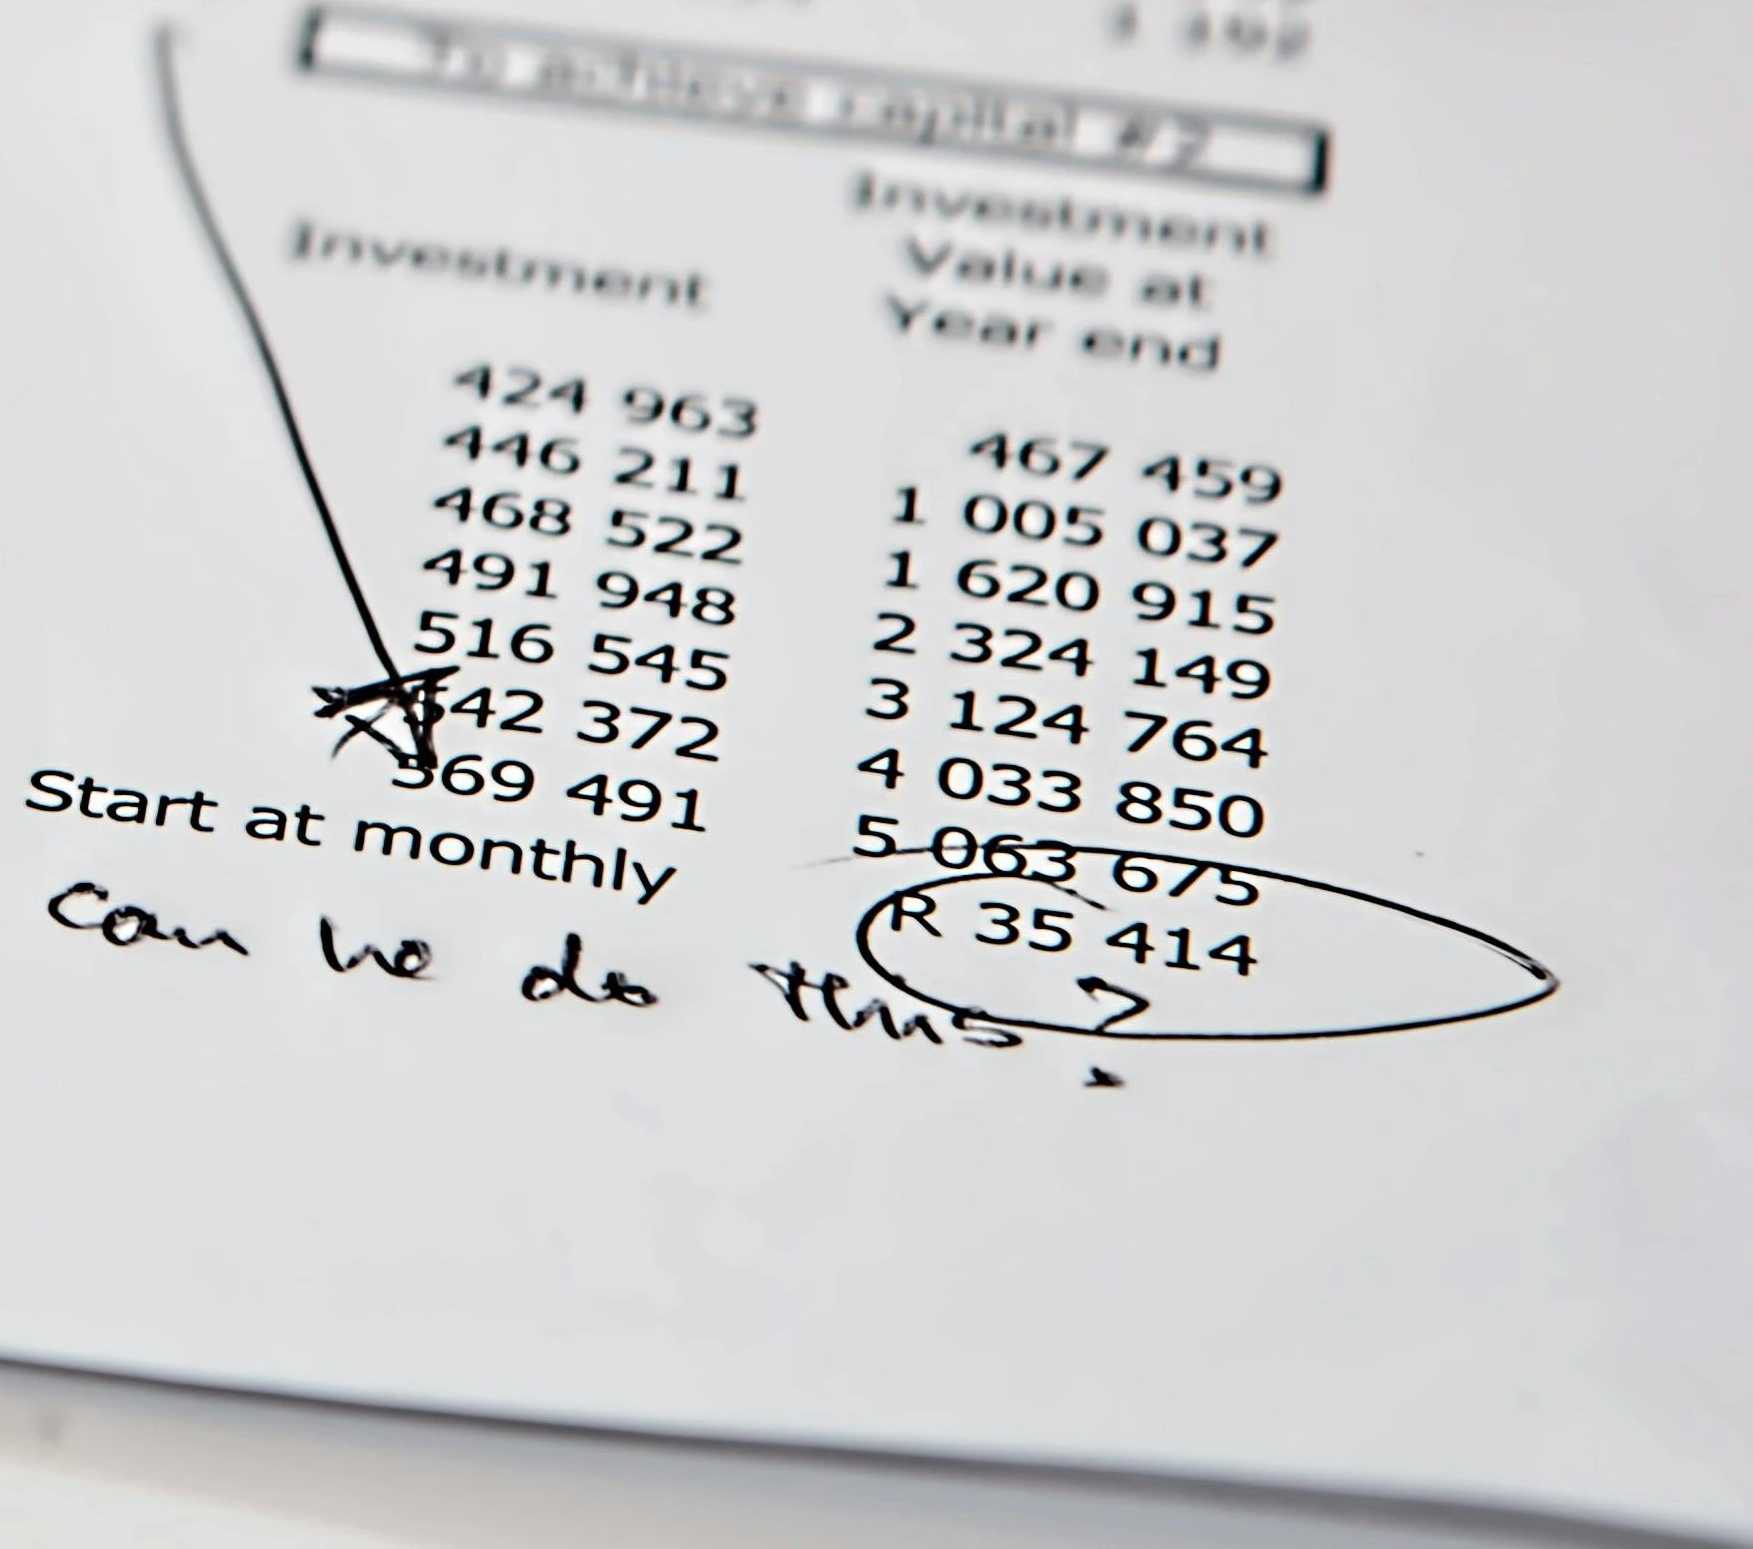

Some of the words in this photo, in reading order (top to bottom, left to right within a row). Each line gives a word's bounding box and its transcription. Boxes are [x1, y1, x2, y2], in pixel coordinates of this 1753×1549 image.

[851, 170, 1276, 261] Investment
[292, 219, 710, 312] Investment
[905, 238, 1108, 301] Value
[1140, 266, 1215, 313] at
[883, 293, 1058, 350] Year
[1080, 321, 1224, 373] end
[453, 363, 589, 416] 424
[622, 385, 759, 439] 963
[442, 424, 581, 476] 446
[614, 446, 747, 503] 211
[968, 432, 1111, 482] 467
[1140, 454, 1283, 505] 459
[433, 487, 572, 537] 468
[605, 509, 744, 565] 522
[892, 486, 925, 526] 1
[962, 494, 1106, 549] 005
[1137, 516, 1281, 570] 037
[422, 548, 559, 600] 491
[595, 570, 737, 626] 948
[885, 551, 919, 589] 1
[955, 559, 1101, 613] 620
[1131, 582, 1276, 636] 915
[413, 610, 556, 665] 516
[587, 633, 731, 692] 545
[872, 613, 918, 654] 2
[949, 623, 1094, 678] 324
[1132, 647, 1272, 701] 149
[576, 699, 721, 762] 372
[865, 678, 911, 720] 3
[949, 691, 1090, 746] 124
[1124, 710, 1269, 770] 764
[566, 773, 707, 833] 491
[856, 749, 904, 790] 4
[937, 756, 1083, 814] 033
[1116, 781, 1266, 838] 850
[24, 768, 219, 834] Start
[244, 803, 325, 847] at
[353, 818, 678, 906] monthly
[853, 814, 899, 858] 5
[930, 826, 1078, 884] 063
[1112, 853, 1260, 907] 675
[520, 932, 660, 1008] do
[891, 891, 943, 938] R
[974, 902, 1075, 952] 35
[1106, 922, 1258, 977] 414
